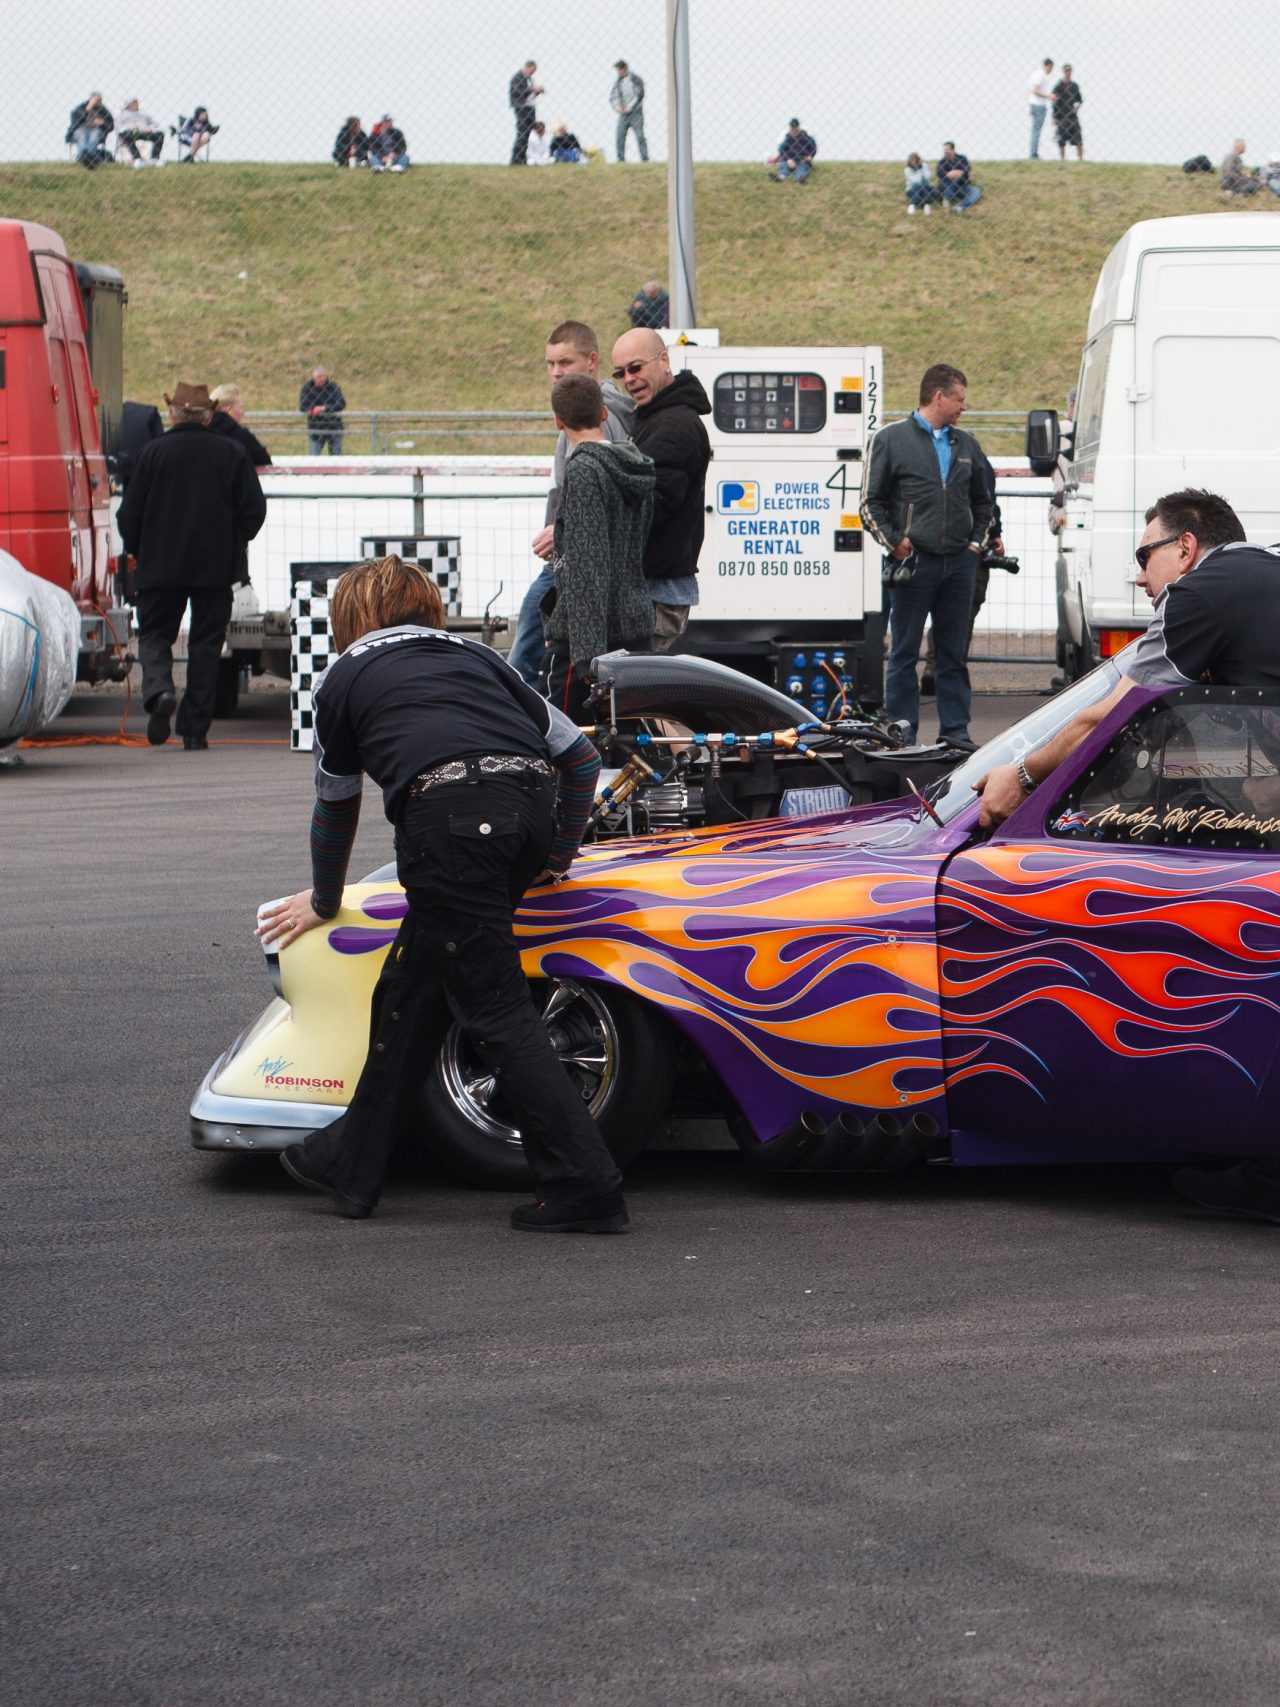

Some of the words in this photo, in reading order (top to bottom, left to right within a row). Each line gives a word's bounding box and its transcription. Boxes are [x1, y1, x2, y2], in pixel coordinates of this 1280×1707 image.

[775, 483, 819, 494] POWER
[764, 498, 830, 510] ELECTRICS
[728, 520, 821, 535] GENERATOR
[744, 540, 803, 555] RENTAL
[718, 561, 755, 576] 0870
[761, 561, 788, 576] 850
[793, 561, 830, 576] 0858
[786, 786, 846, 816] STROUD
[1085, 804, 1162, 836] Andy
[264, 1084, 301, 1092] RACE
[307, 1086, 344, 1095] CARS
[265, 1075, 345, 1089] ROBINSON
